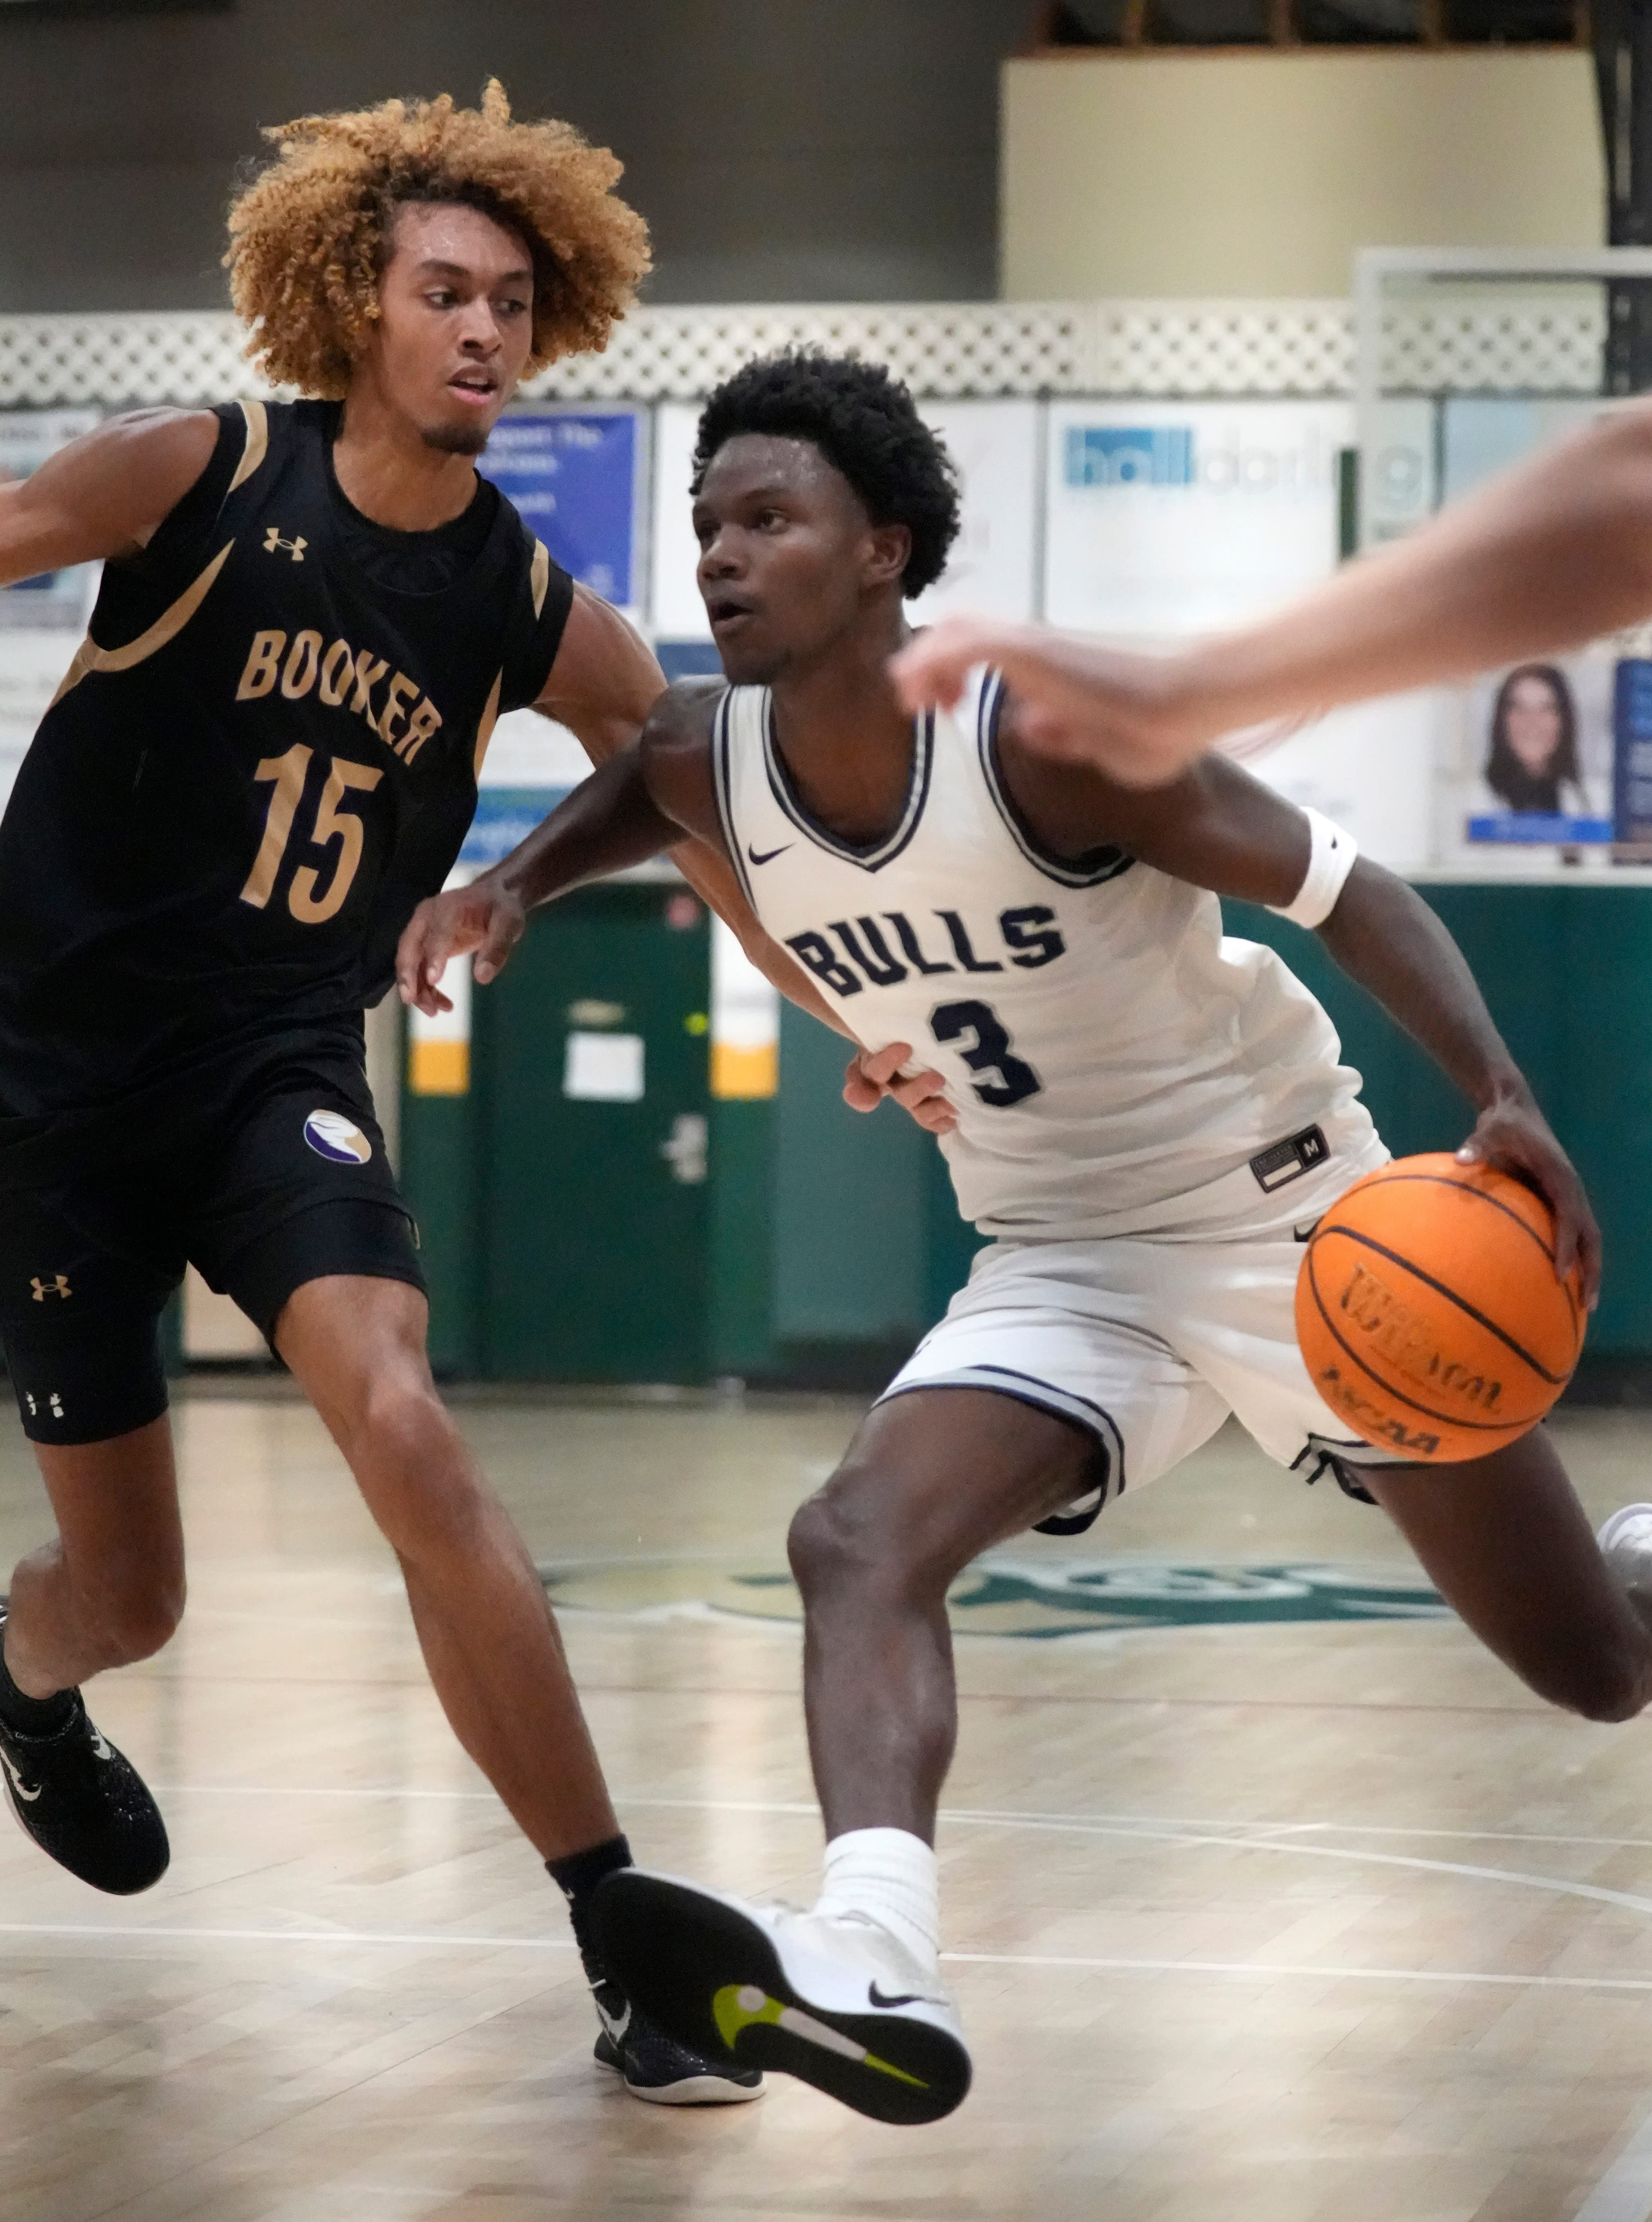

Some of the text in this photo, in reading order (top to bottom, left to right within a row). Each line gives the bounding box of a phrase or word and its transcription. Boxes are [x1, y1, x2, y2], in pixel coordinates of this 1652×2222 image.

[235, 630, 443, 766] BOOKER
[239, 743, 385, 924] 15
[783, 905, 1067, 997] BULLS
[928, 999, 1045, 1107] 3
[1303, 1138, 1320, 1157] M
